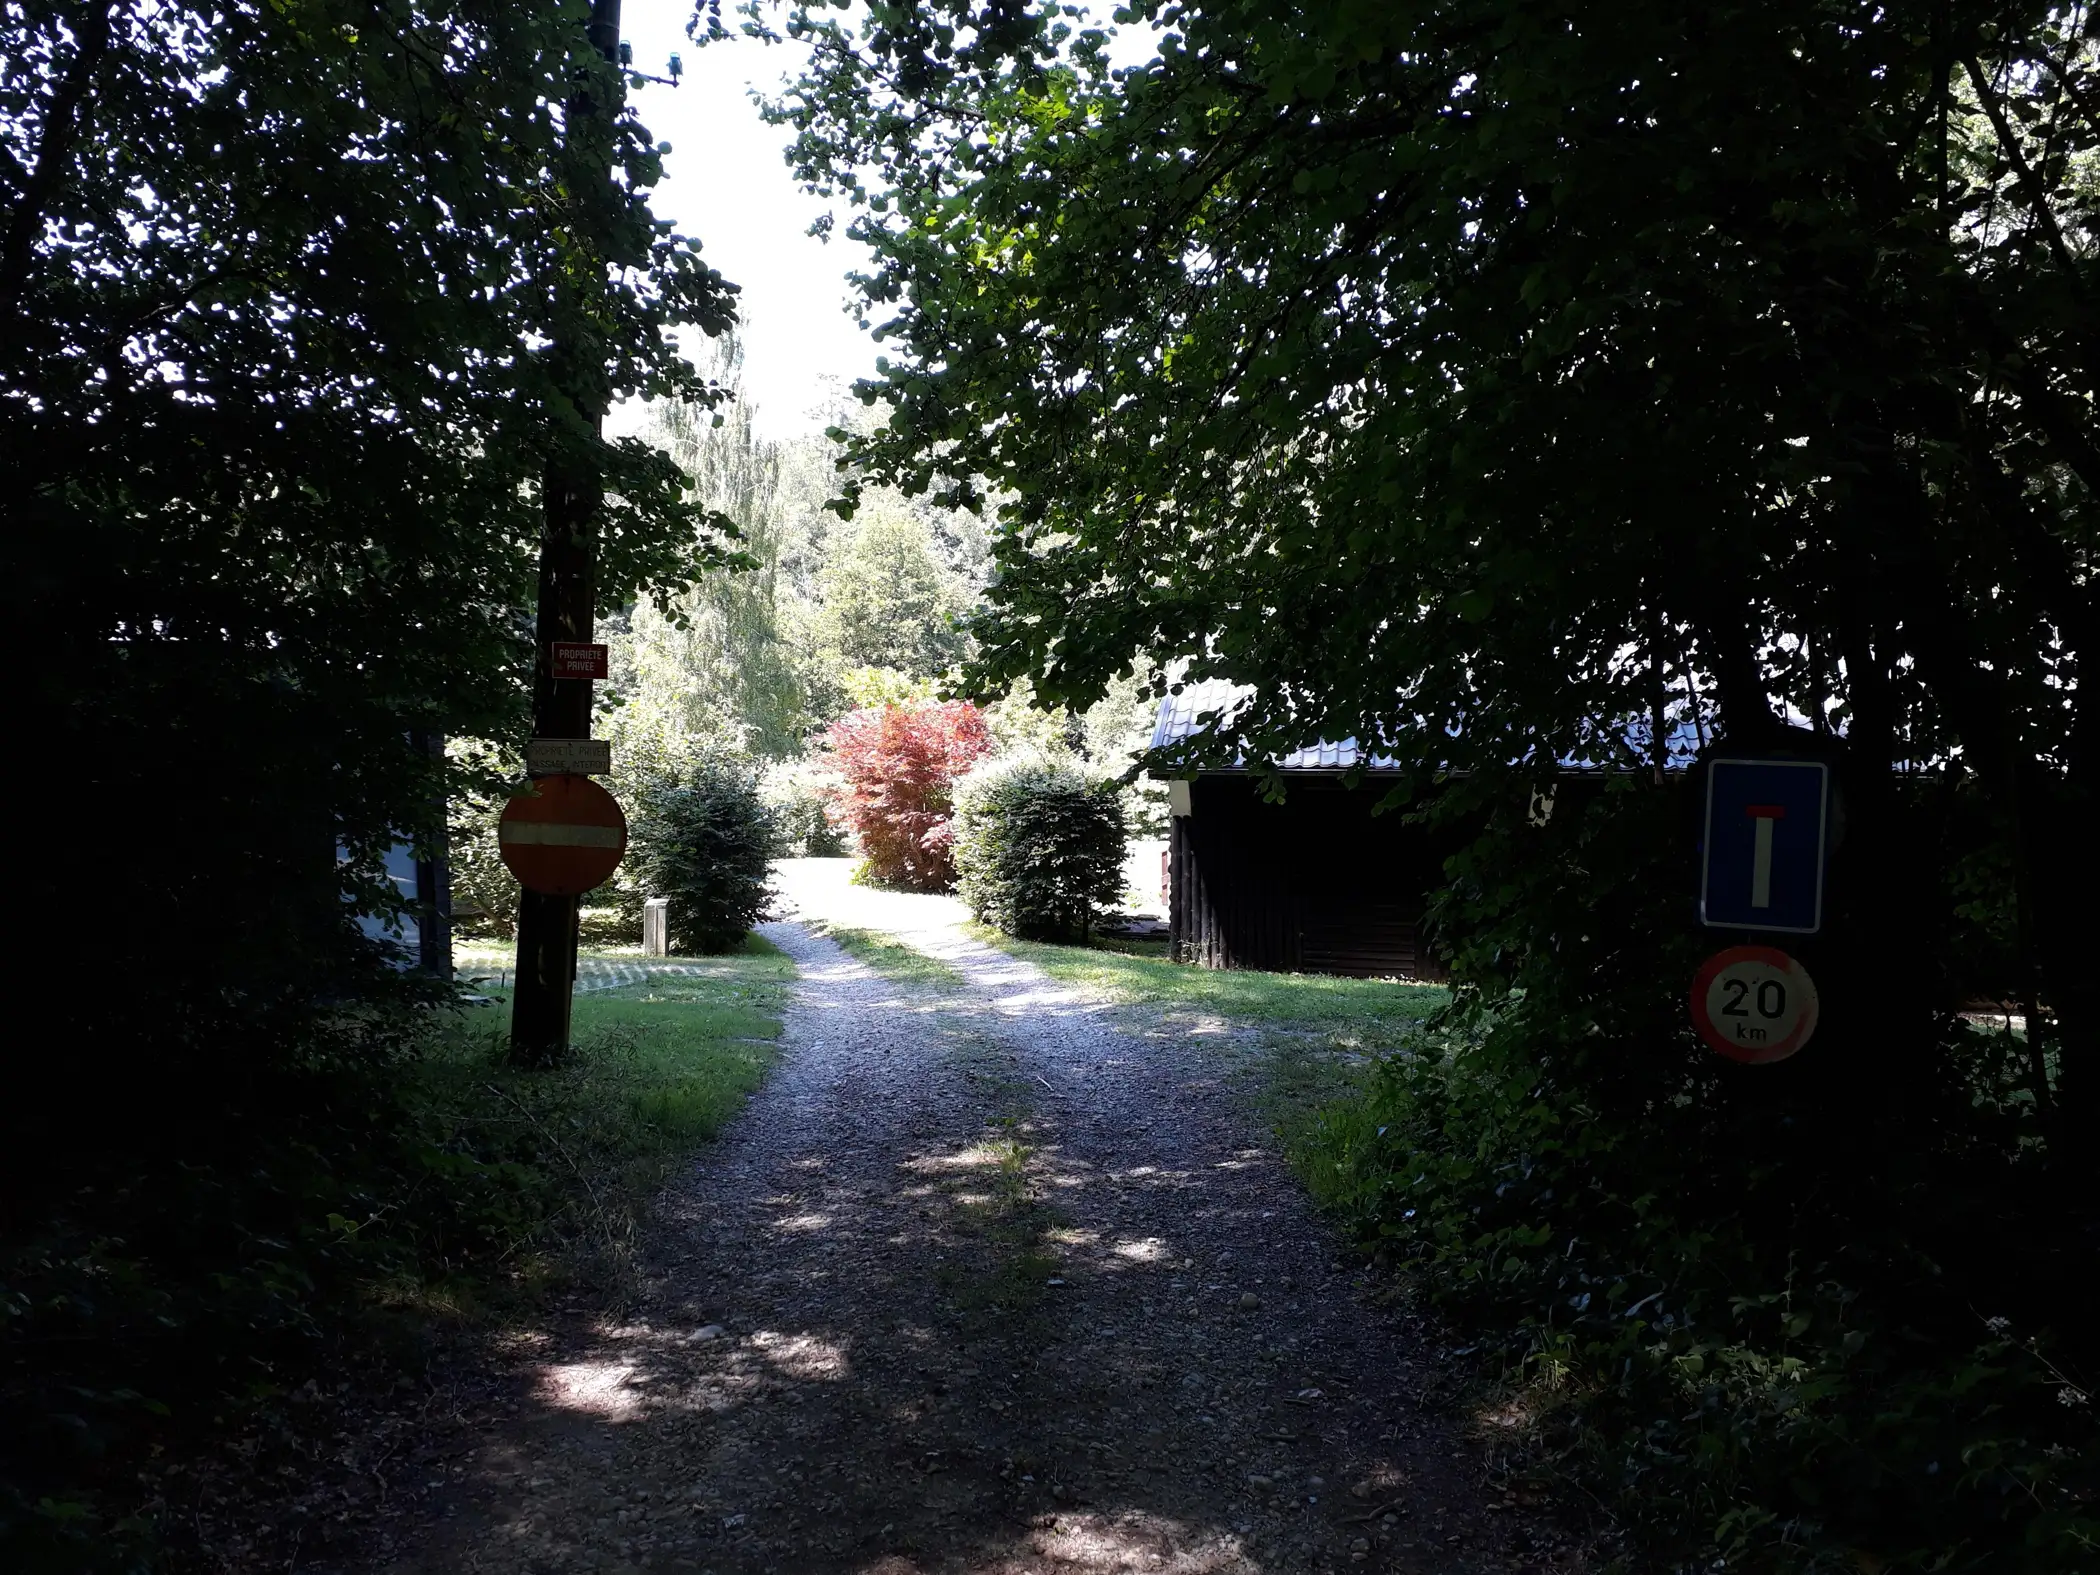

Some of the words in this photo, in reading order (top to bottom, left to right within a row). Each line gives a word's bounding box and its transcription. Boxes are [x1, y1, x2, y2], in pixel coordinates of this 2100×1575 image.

[559, 648, 603, 660] PROPRIÉTÉ
[567, 660, 596, 671] PRIVÉE
[1722, 979, 1786, 1018] 20
[1736, 1022, 1767, 1041] km
